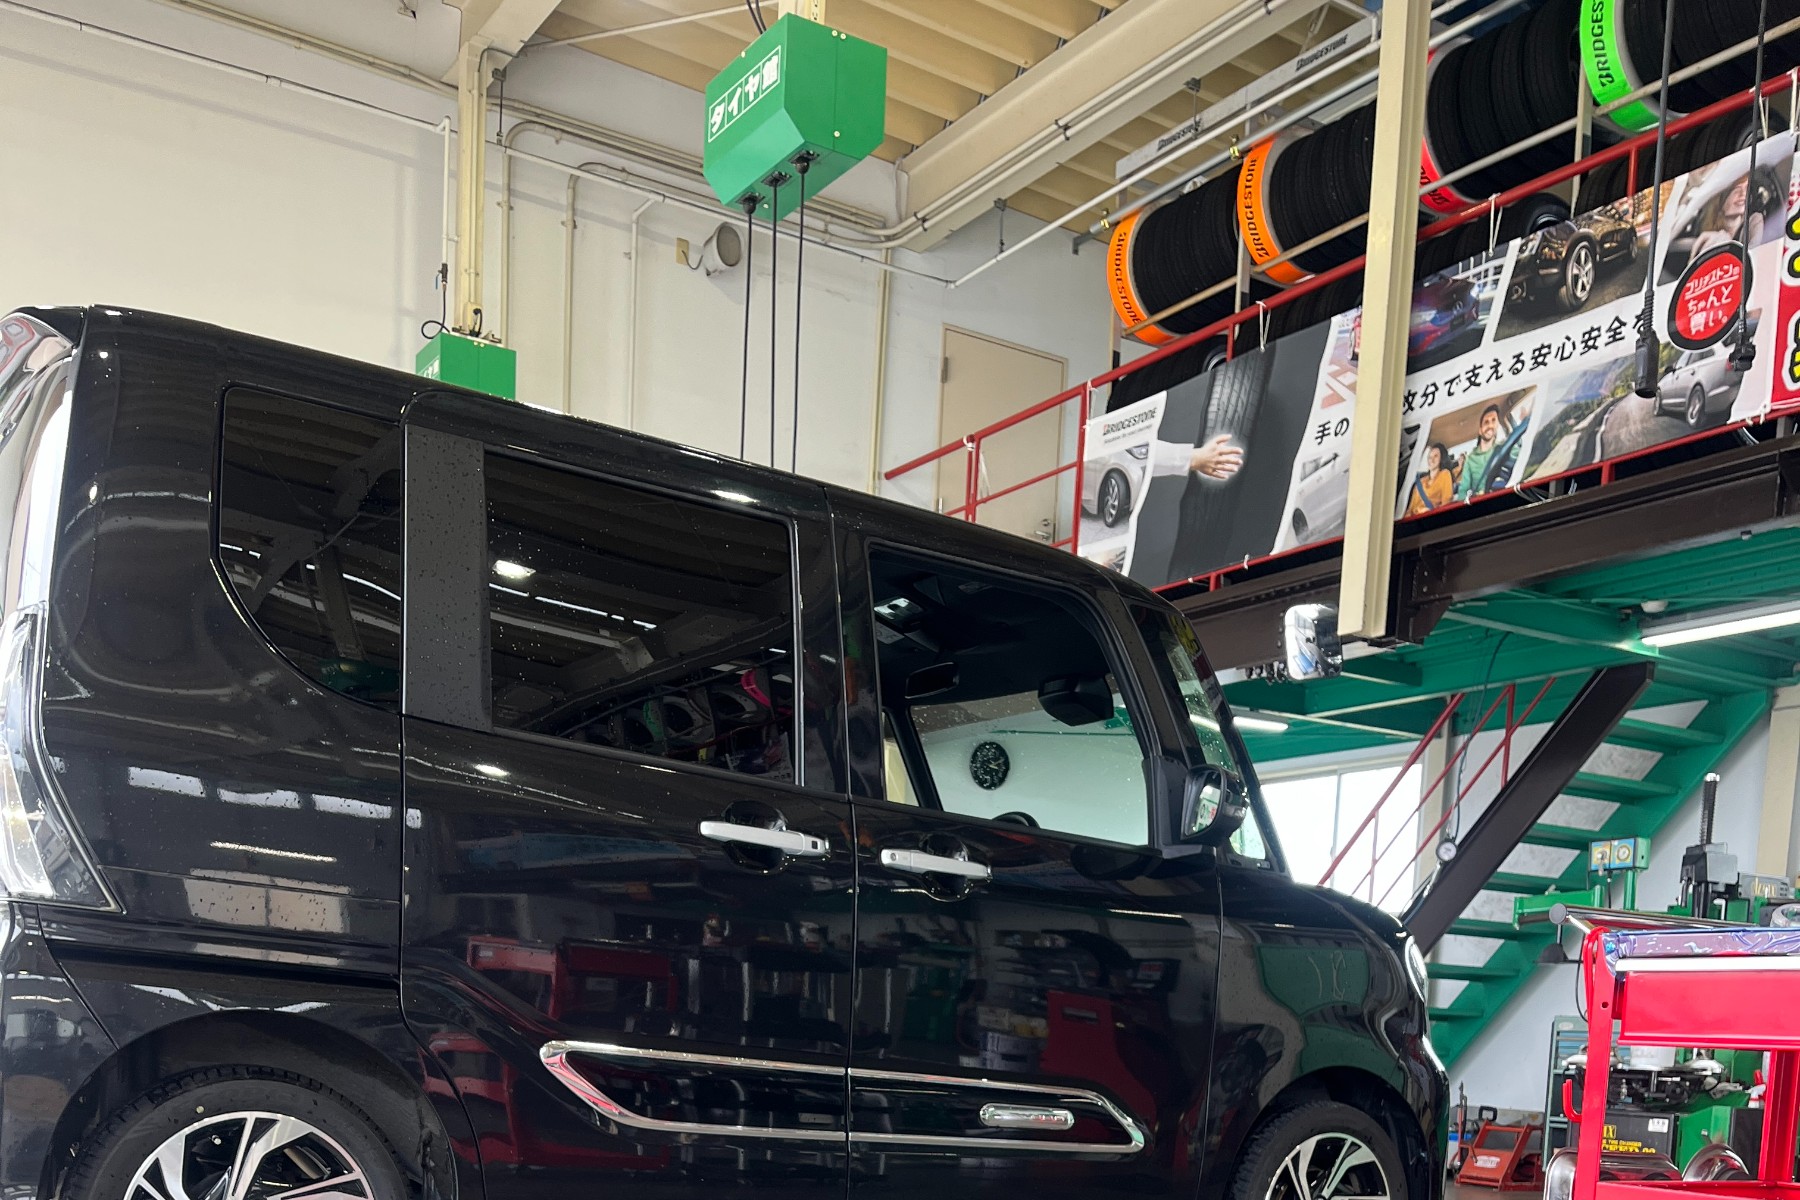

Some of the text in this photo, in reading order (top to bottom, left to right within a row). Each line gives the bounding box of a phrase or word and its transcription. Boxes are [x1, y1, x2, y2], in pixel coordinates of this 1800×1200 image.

[1591, 0, 1616, 88] BRIDGES
[709, 54, 779, 134] タイヤ館
[1243, 157, 1270, 258] BRIDGESTONE
[1687, 283, 1733, 317] ちゃんと
[1102, 407, 1157, 436] BRIDGESTONE
